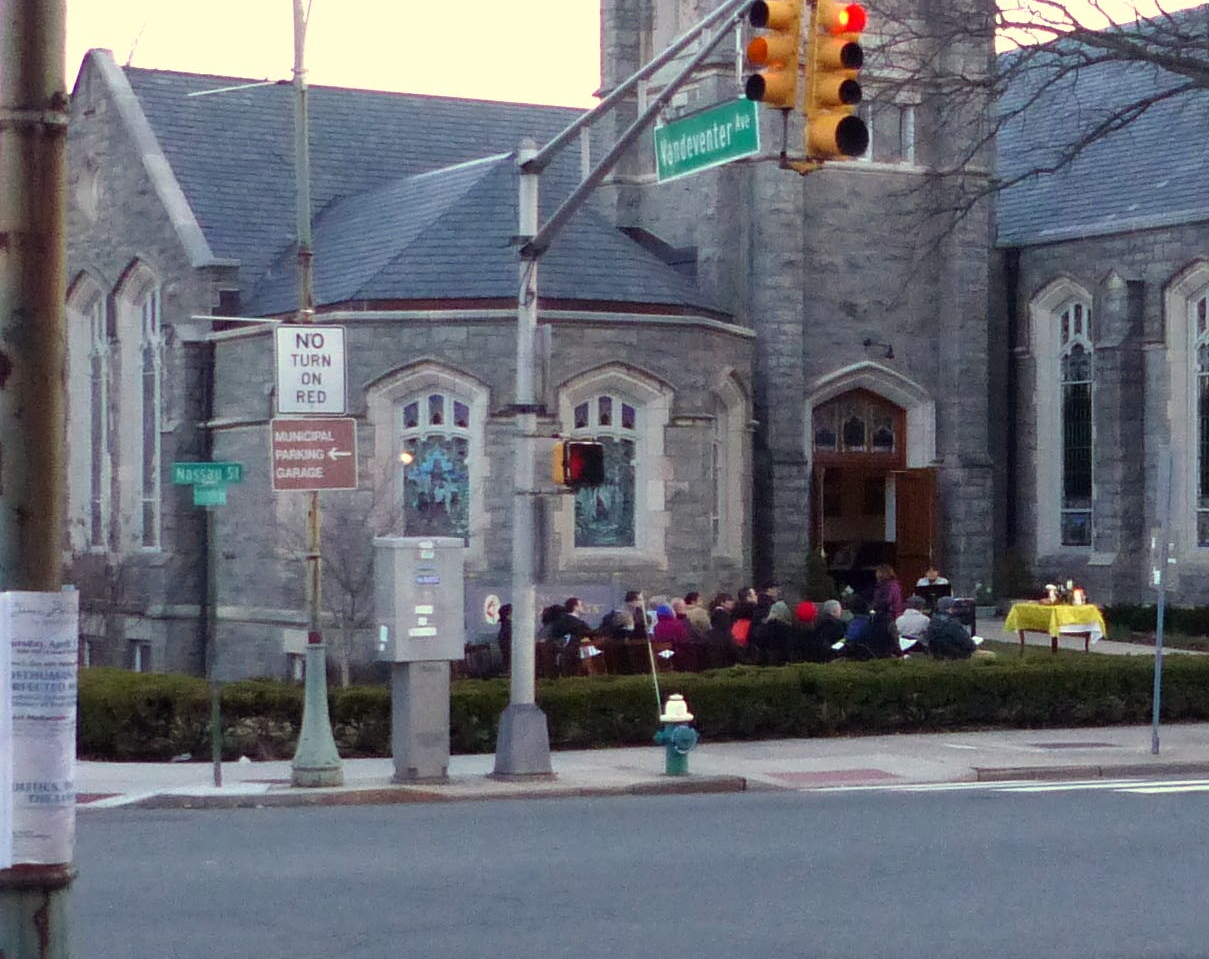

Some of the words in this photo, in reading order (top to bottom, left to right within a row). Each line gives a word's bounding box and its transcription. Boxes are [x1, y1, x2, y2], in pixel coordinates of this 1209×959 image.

[660, 121, 732, 166] Vandeventer
[735, 113, 750, 131] Ave
[296, 333, 325, 349] NO
[291, 354, 332, 367] TURN
[301, 372, 322, 385] ON
[296, 391, 327, 404] RED
[275, 431, 334, 442] MUNICIPAL
[275, 449, 325, 460] PARKING
[176, 467, 222, 481] Nassau
[276, 468, 324, 479] GARAGE
